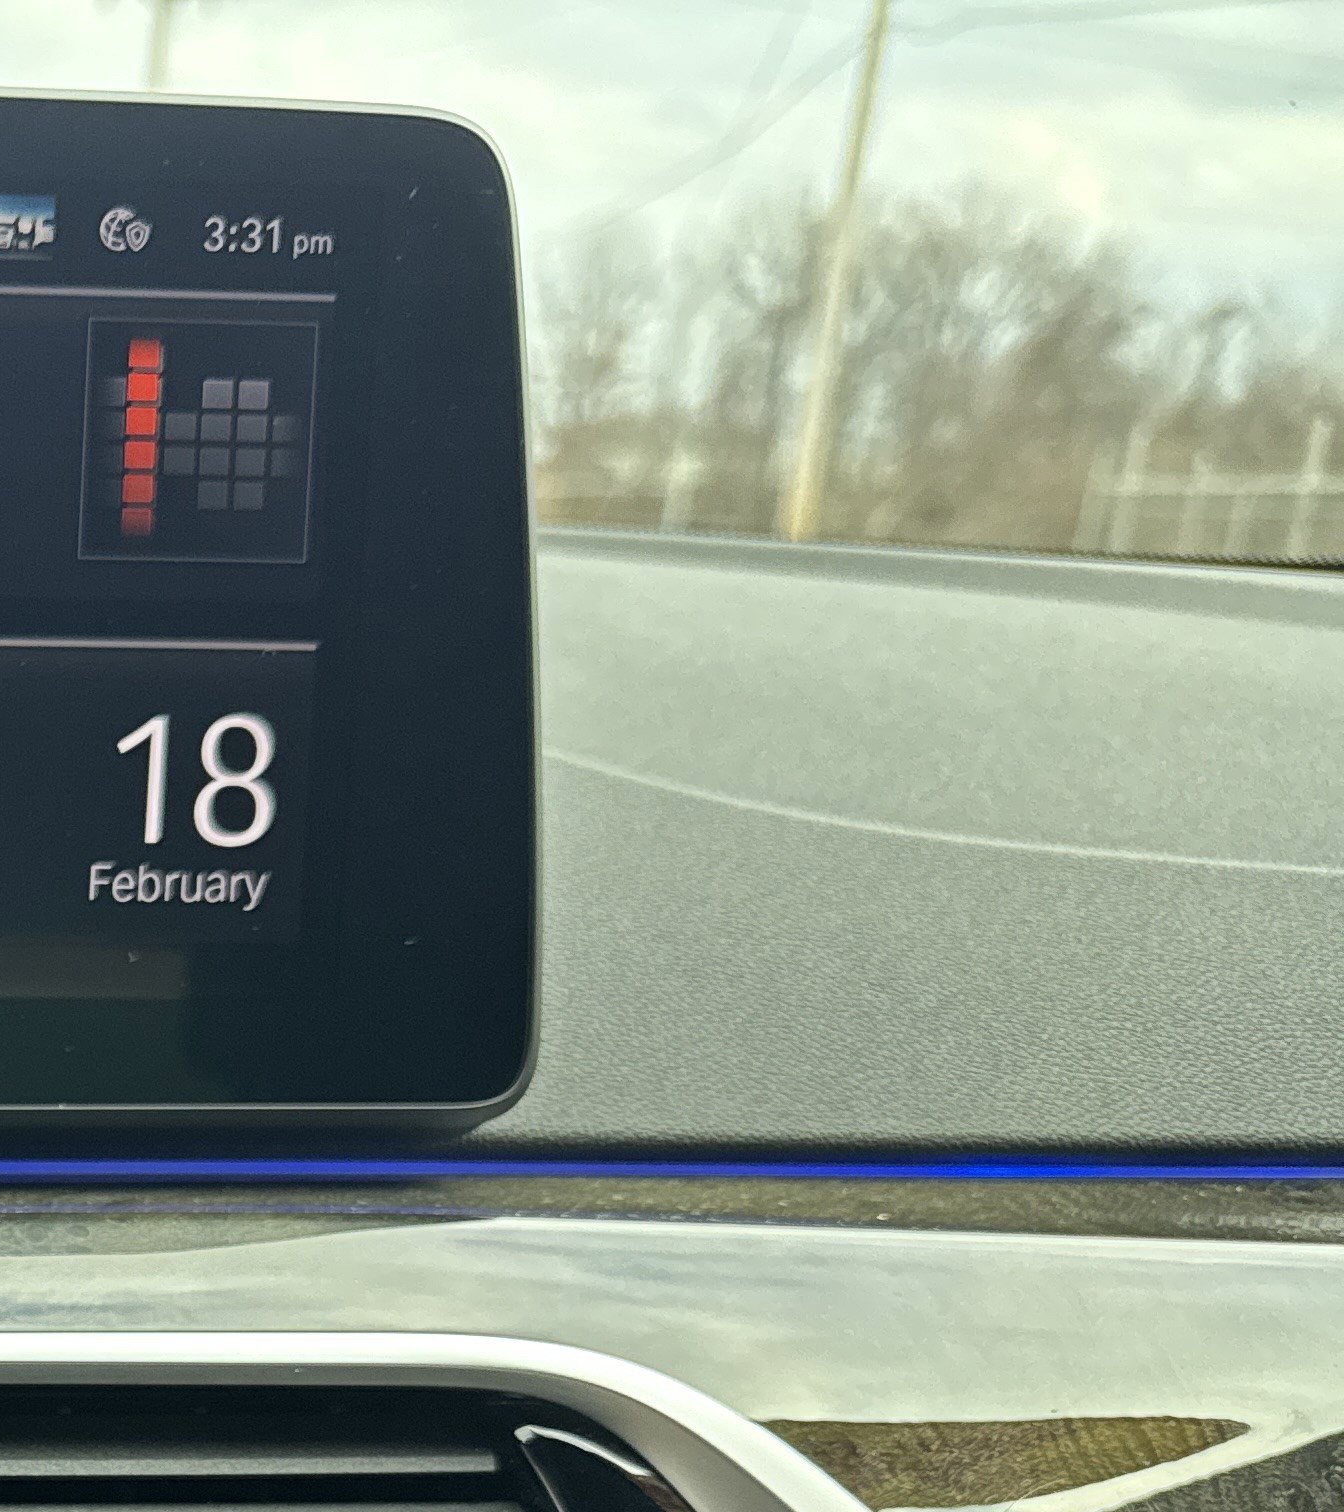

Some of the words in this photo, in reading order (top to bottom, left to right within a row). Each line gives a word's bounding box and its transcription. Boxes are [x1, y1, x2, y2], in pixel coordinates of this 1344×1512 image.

[203, 215, 283, 256] 3:31
[293, 229, 335, 260] pm
[116, 712, 278, 848] 18
[87, 862, 270, 912] February
